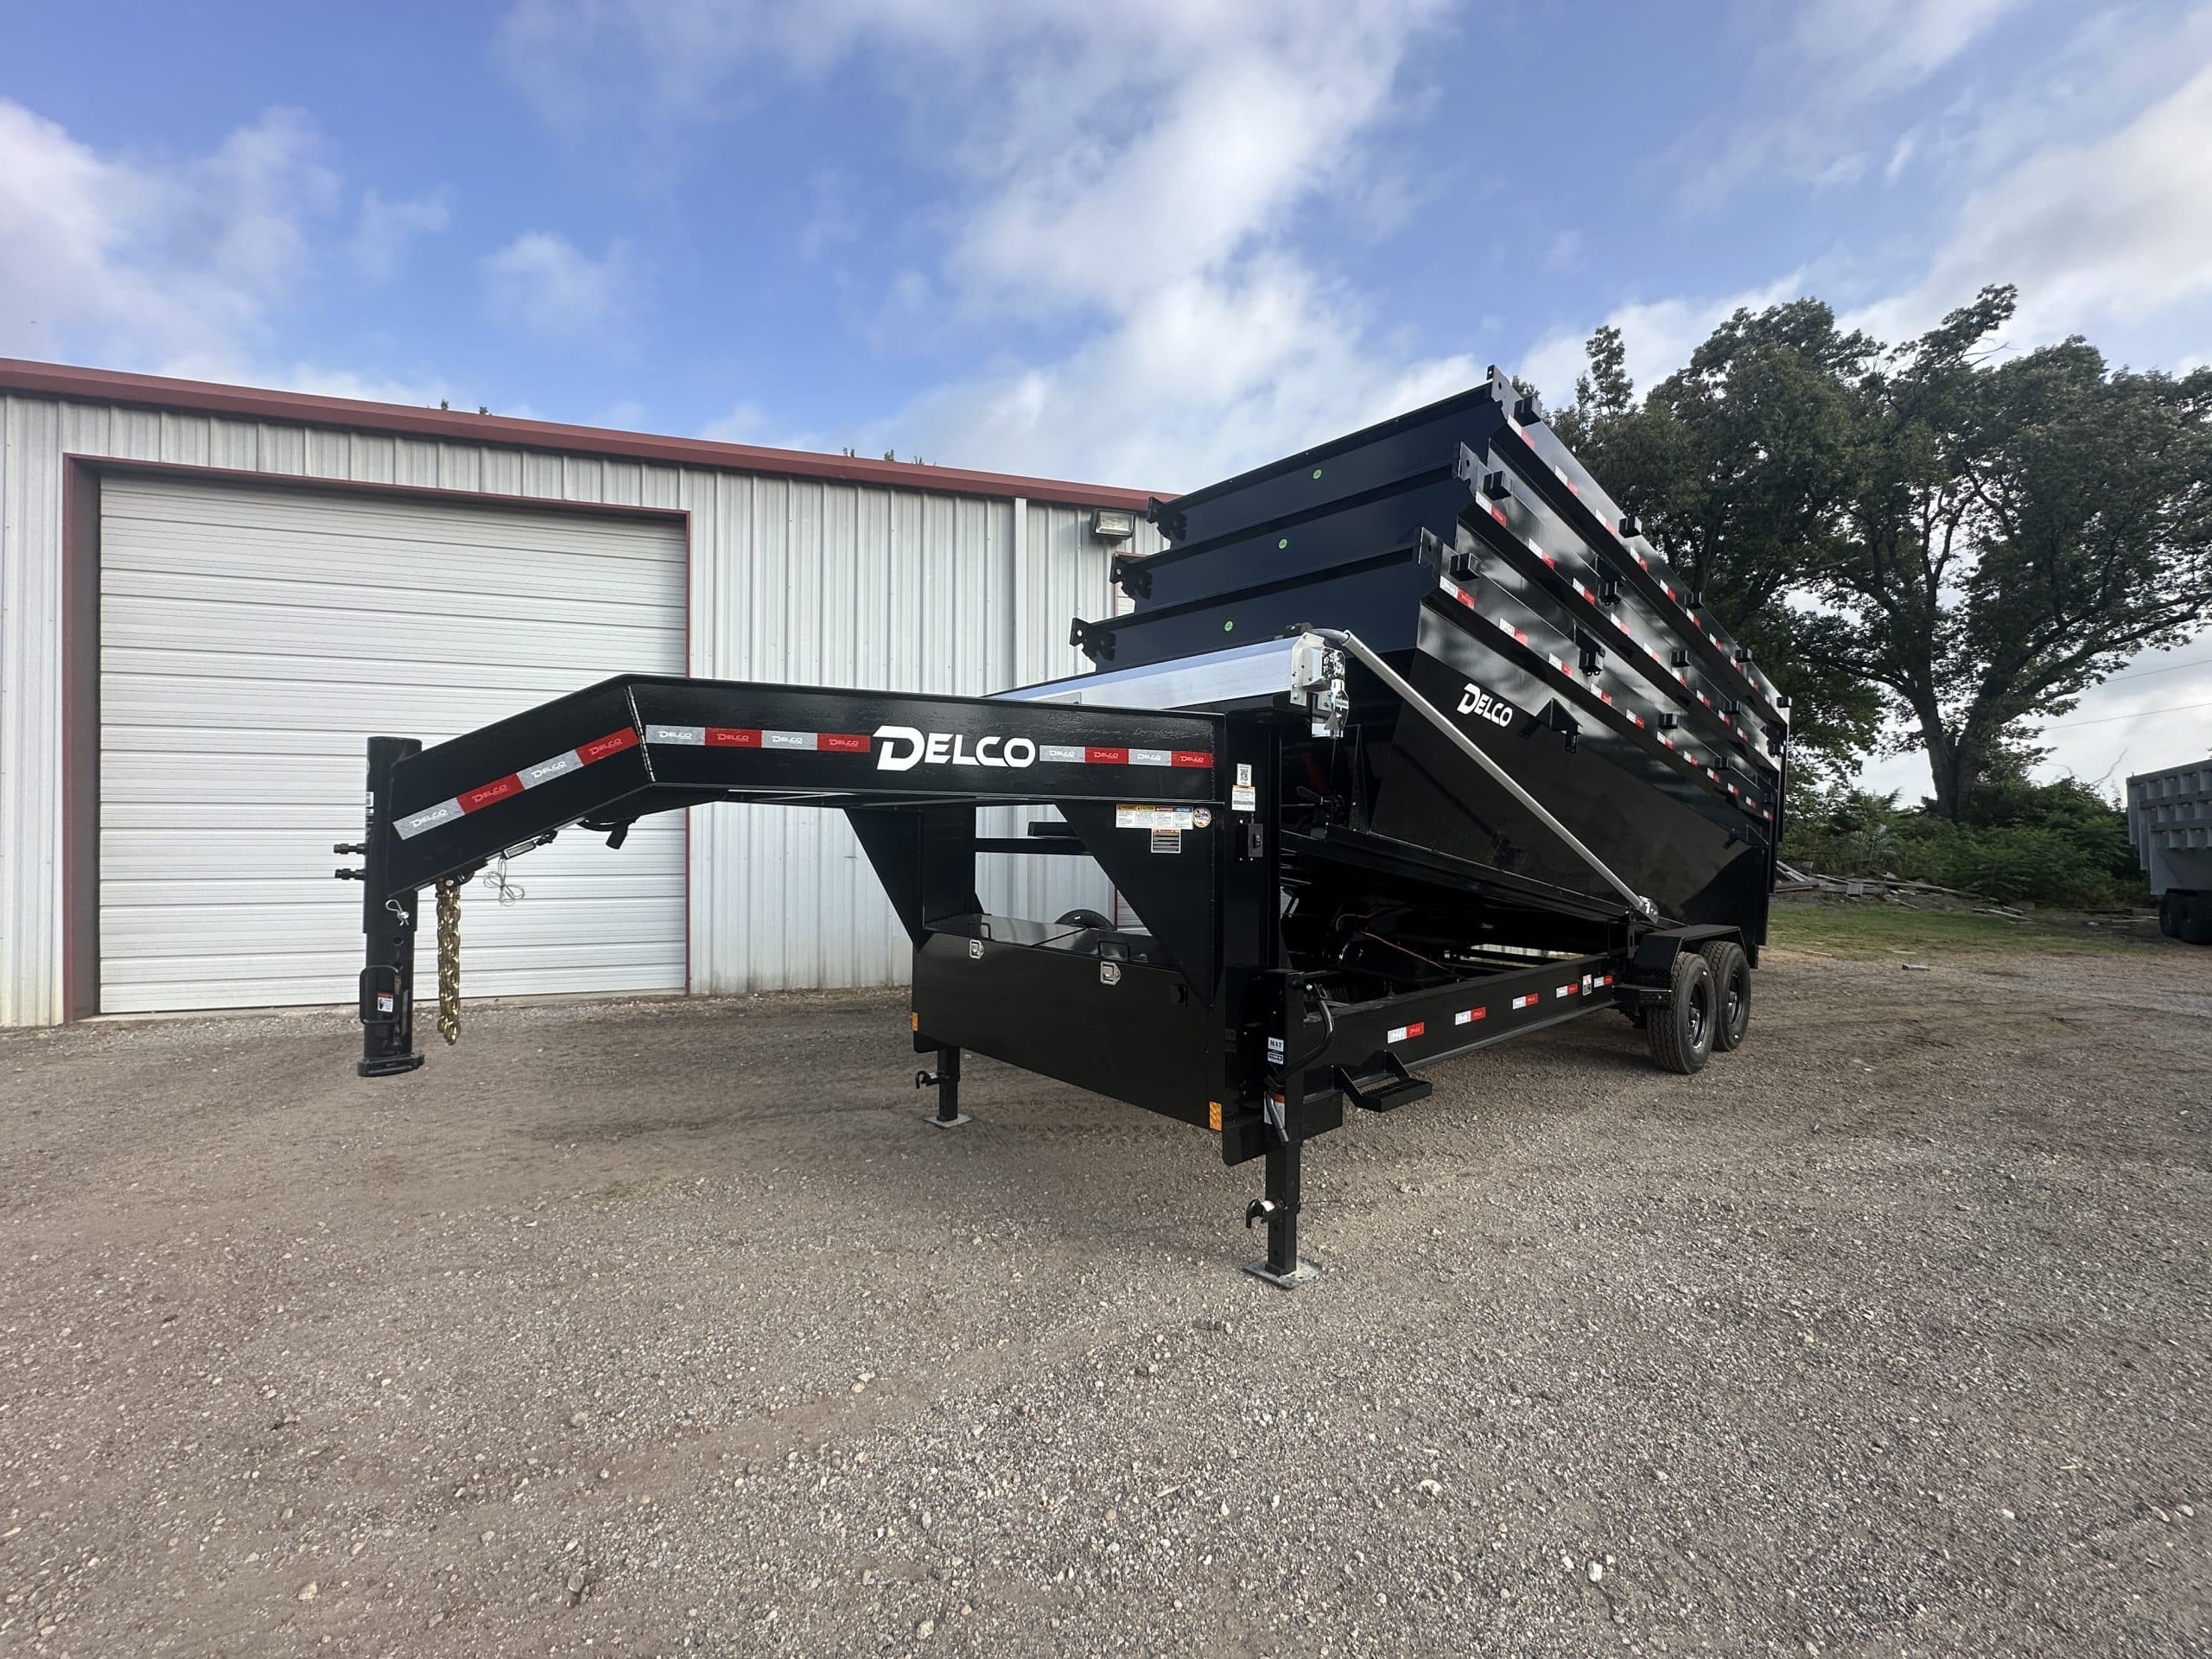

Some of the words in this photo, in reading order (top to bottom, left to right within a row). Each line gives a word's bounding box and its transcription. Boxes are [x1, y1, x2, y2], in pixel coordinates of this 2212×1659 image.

[1457, 683, 1513, 728] DELCO
[658, 730, 692, 739] DELCO
[717, 733, 750, 741] DELCO
[771, 734, 803, 743] DELCO
[829, 738, 859, 747] DELCO
[589, 737, 621, 756] DELCO
[872, 725, 1036, 772] DELCO
[531, 760, 566, 779] DELCO
[472, 784, 507, 803] DELCO
[410, 809, 447, 828] DELCO
